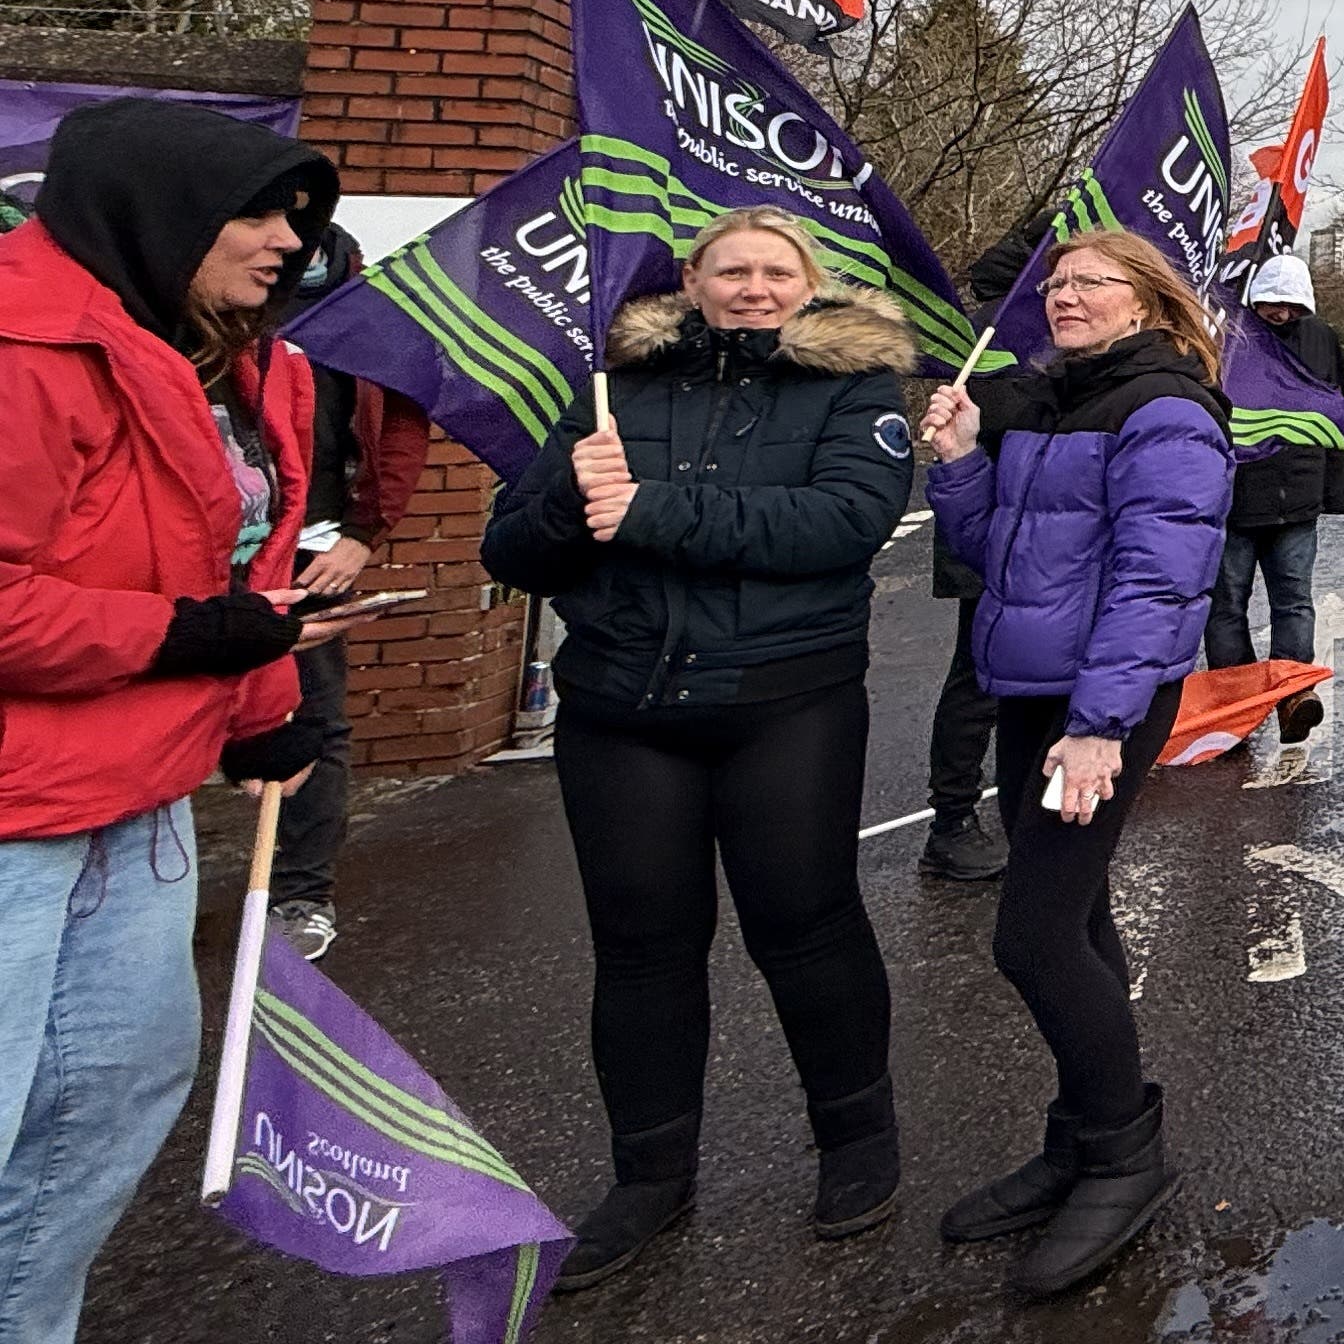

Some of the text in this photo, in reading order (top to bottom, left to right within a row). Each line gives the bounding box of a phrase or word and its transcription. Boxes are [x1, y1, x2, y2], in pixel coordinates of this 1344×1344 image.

[1141, 188, 1206, 283] the public
[479, 246, 517, 276] the
[504, 275, 573, 327] public
